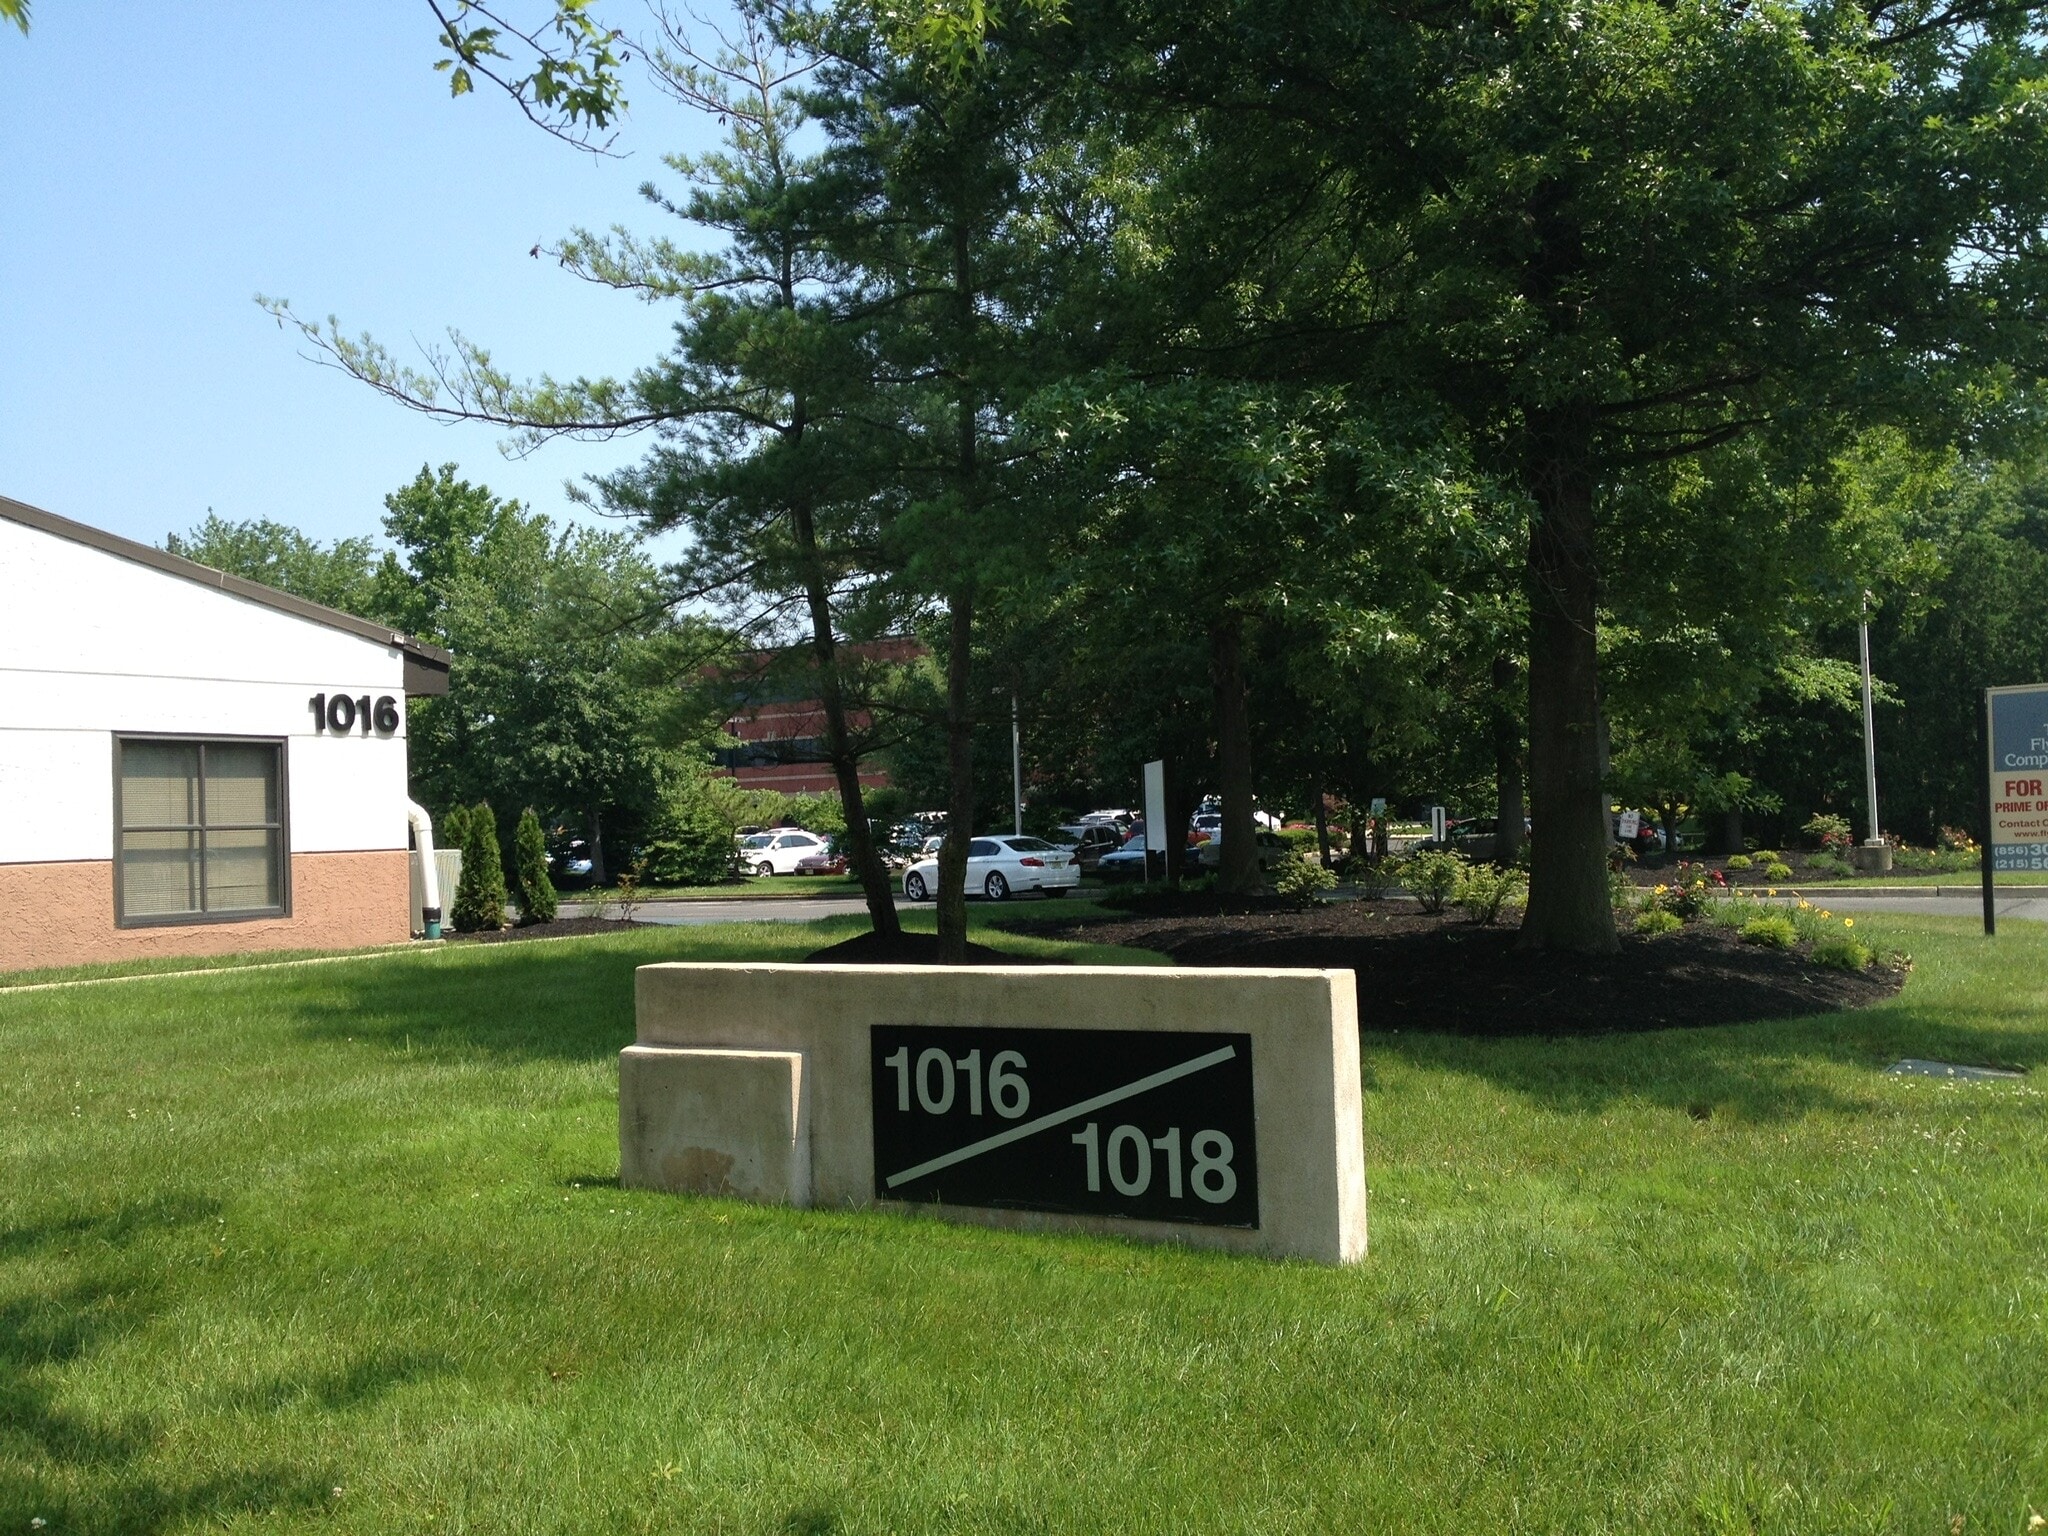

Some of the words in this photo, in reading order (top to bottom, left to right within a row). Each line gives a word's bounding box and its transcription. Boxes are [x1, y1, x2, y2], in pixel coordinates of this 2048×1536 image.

[309, 693, 399, 734] 1016
[2005, 779, 2042, 797] FOR
[1995, 801, 2032, 813] PRIME
[1999, 819, 2040, 828] Contact
[1995, 846, 2028, 857] (856)
[1996, 859, 2028, 869] (215)
[885, 1046, 1030, 1119] 1016
[1072, 1122, 1237, 1204] 1018
